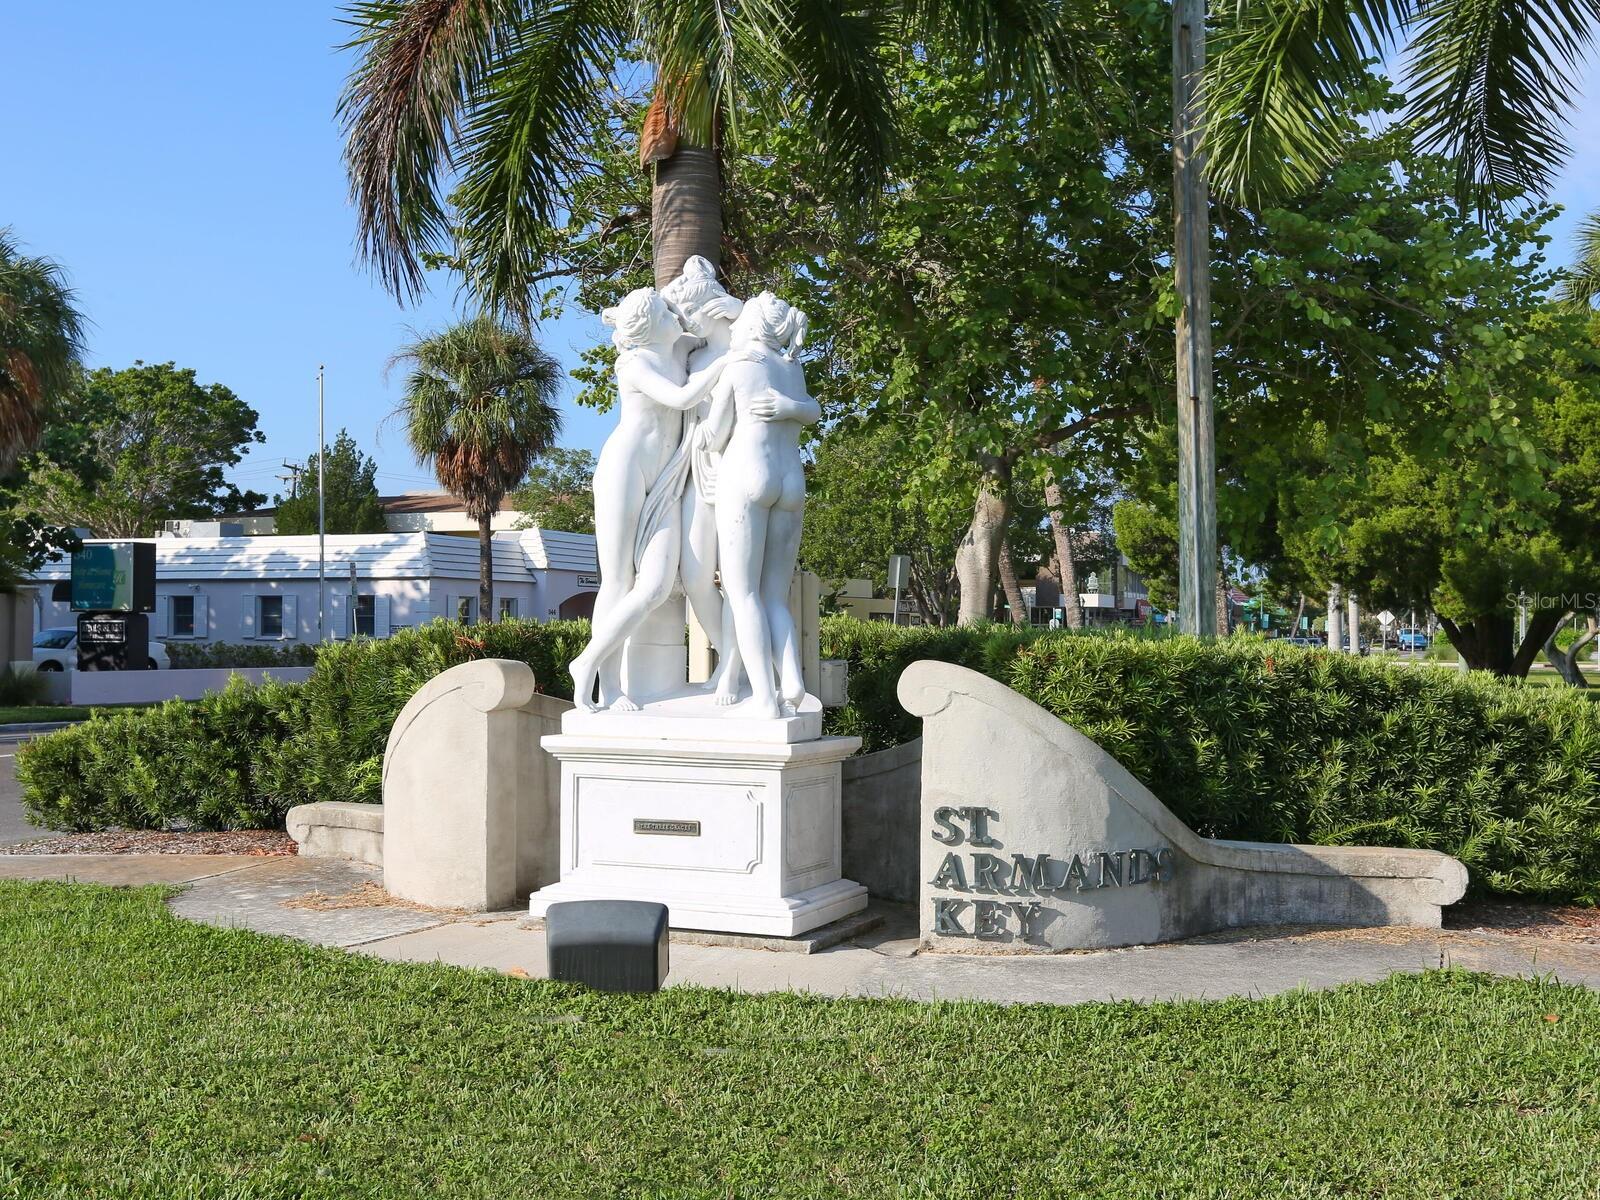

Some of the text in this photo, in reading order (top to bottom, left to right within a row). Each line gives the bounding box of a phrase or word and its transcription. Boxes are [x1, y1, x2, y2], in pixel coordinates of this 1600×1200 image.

[932, 806, 993, 845] ST.
[928, 849, 1174, 895] ARMANDS
[931, 897, 1042, 938] KEY
